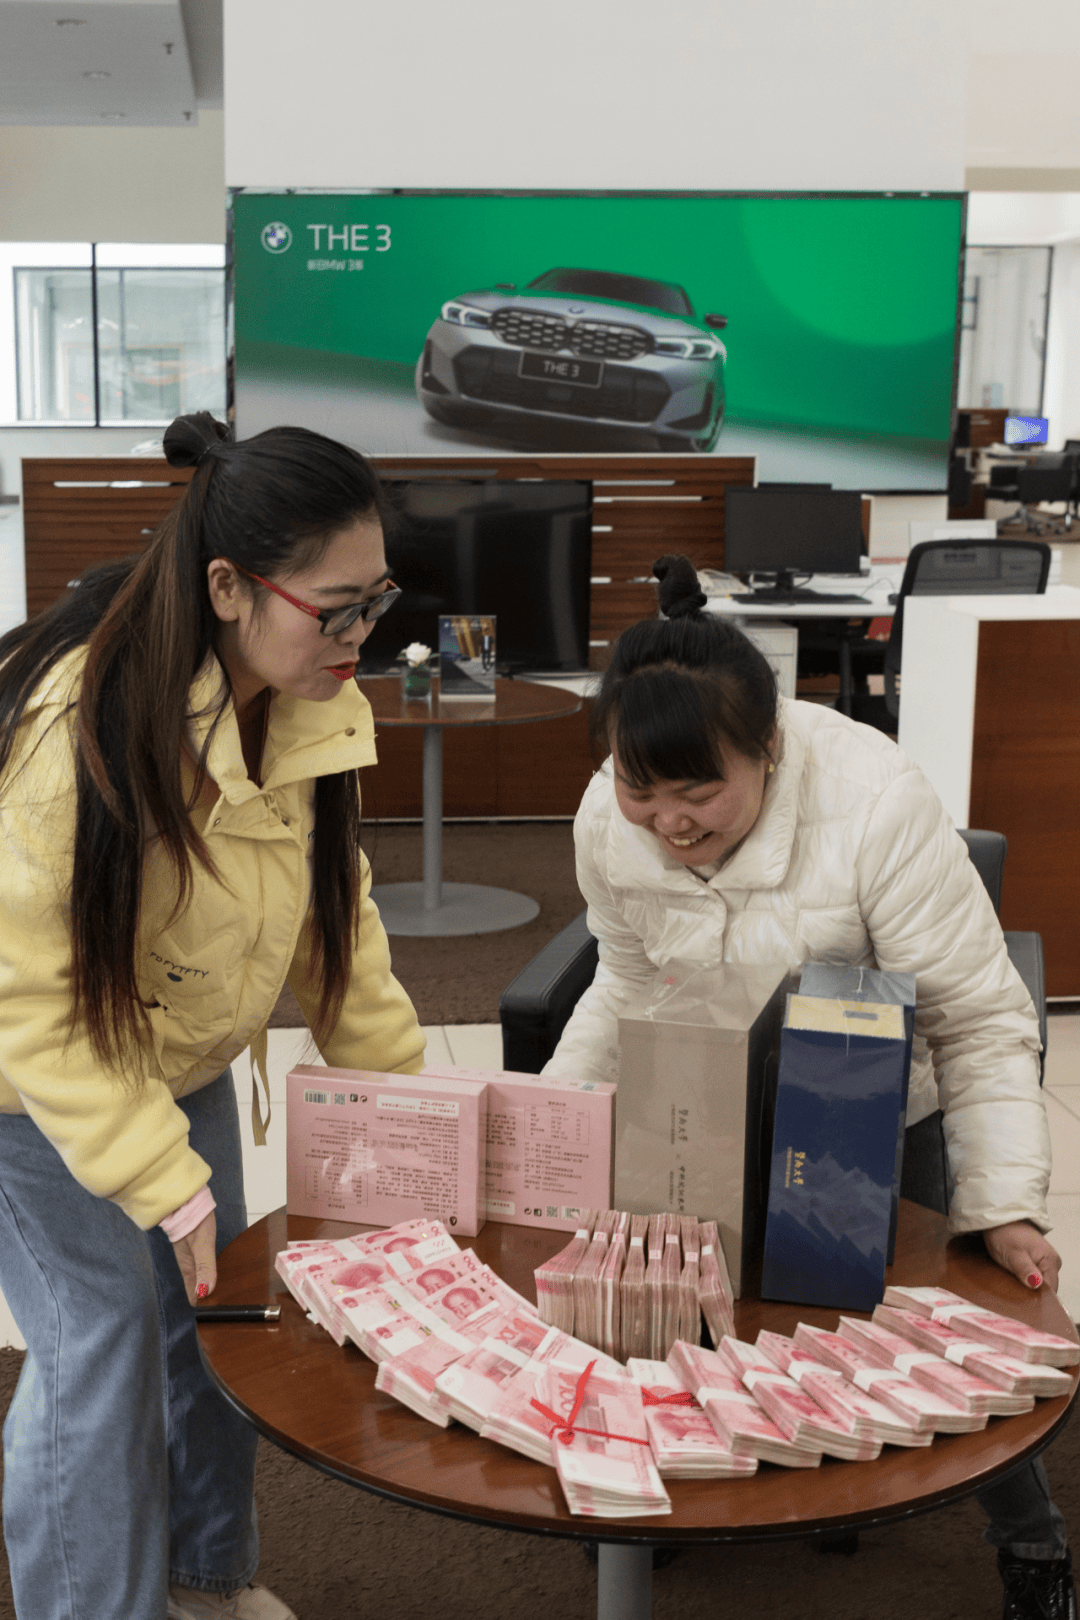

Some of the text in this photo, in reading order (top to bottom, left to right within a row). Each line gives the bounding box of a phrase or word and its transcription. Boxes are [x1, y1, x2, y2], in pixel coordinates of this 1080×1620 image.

[306, 224, 391, 252] THE 3
[543, 360, 580, 379] THE 3
